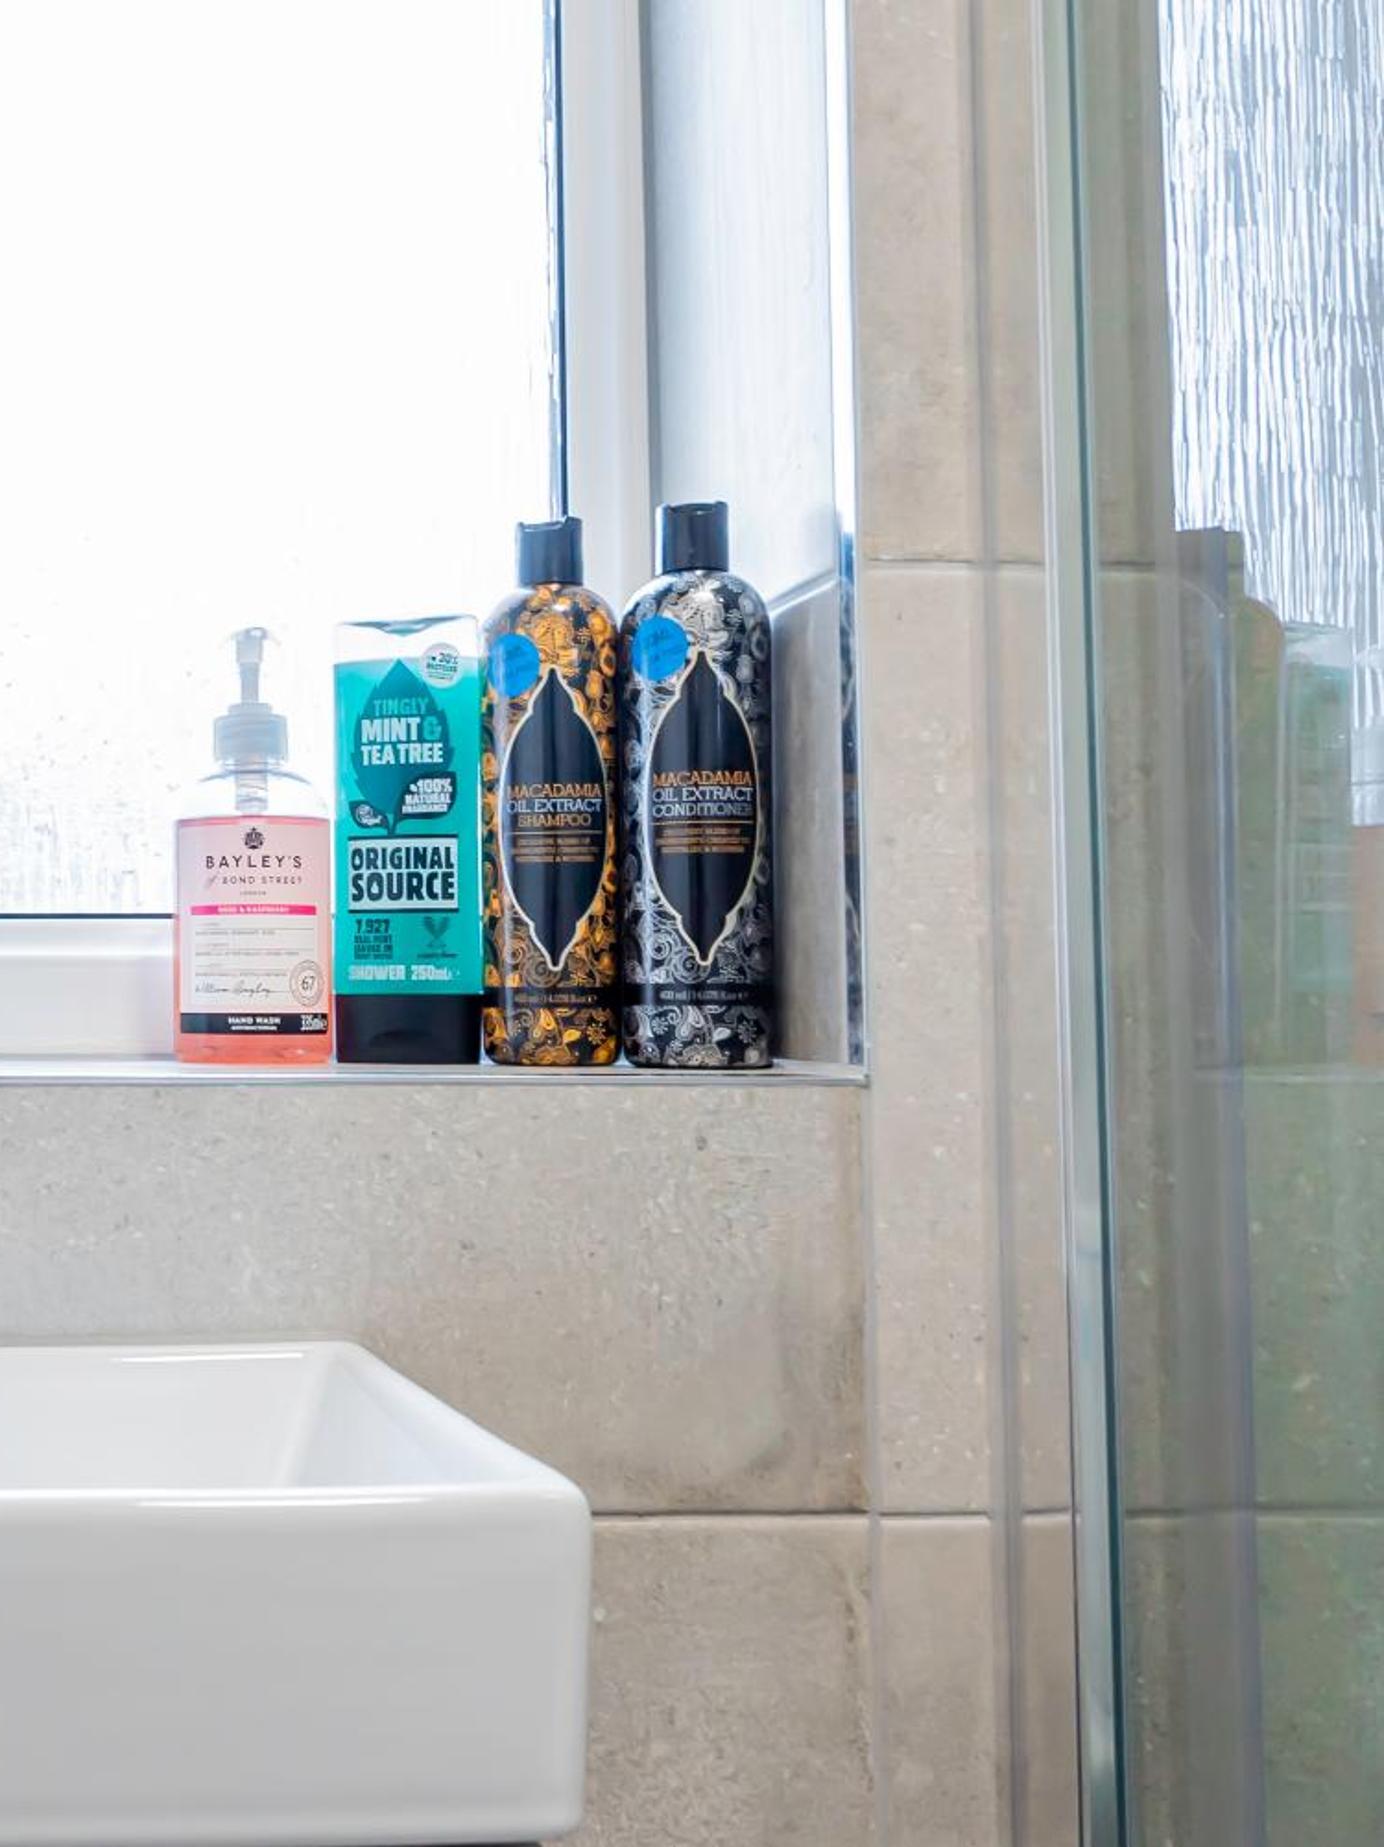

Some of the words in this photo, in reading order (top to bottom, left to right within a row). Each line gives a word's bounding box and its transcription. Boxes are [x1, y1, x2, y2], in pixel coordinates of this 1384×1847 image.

[374, 698, 429, 716] TINGLY
[361, 717, 421, 744] MINT
[423, 716, 442, 740] &
[361, 744, 396, 766] TEA
[397, 743, 444, 764] TREE
[653, 770, 752, 787] MACADAMIA
[506, 783, 602, 800] MACADAMIA
[653, 788, 678, 803] OIL
[682, 786, 754, 802] EXTRACT
[506, 799, 531, 813] OIL
[534, 798, 602, 813] EXTRACT
[653, 801, 754, 818] CONDITIONER
[518, 813, 592, 828] SHAMPOO
[205, 855, 303, 869] BAYLEY'S
[351, 846, 455, 871] ORIGINAL
[221, 876, 256, 885] BOND
[261, 875, 303, 885] STREET
[351, 870, 456, 902] SOURCE
[349, 964, 406, 981] SHOWER
[301, 975, 316, 992] 67
[228, 1015, 254, 1025] HAND
[255, 1015, 281, 1025] WASH
